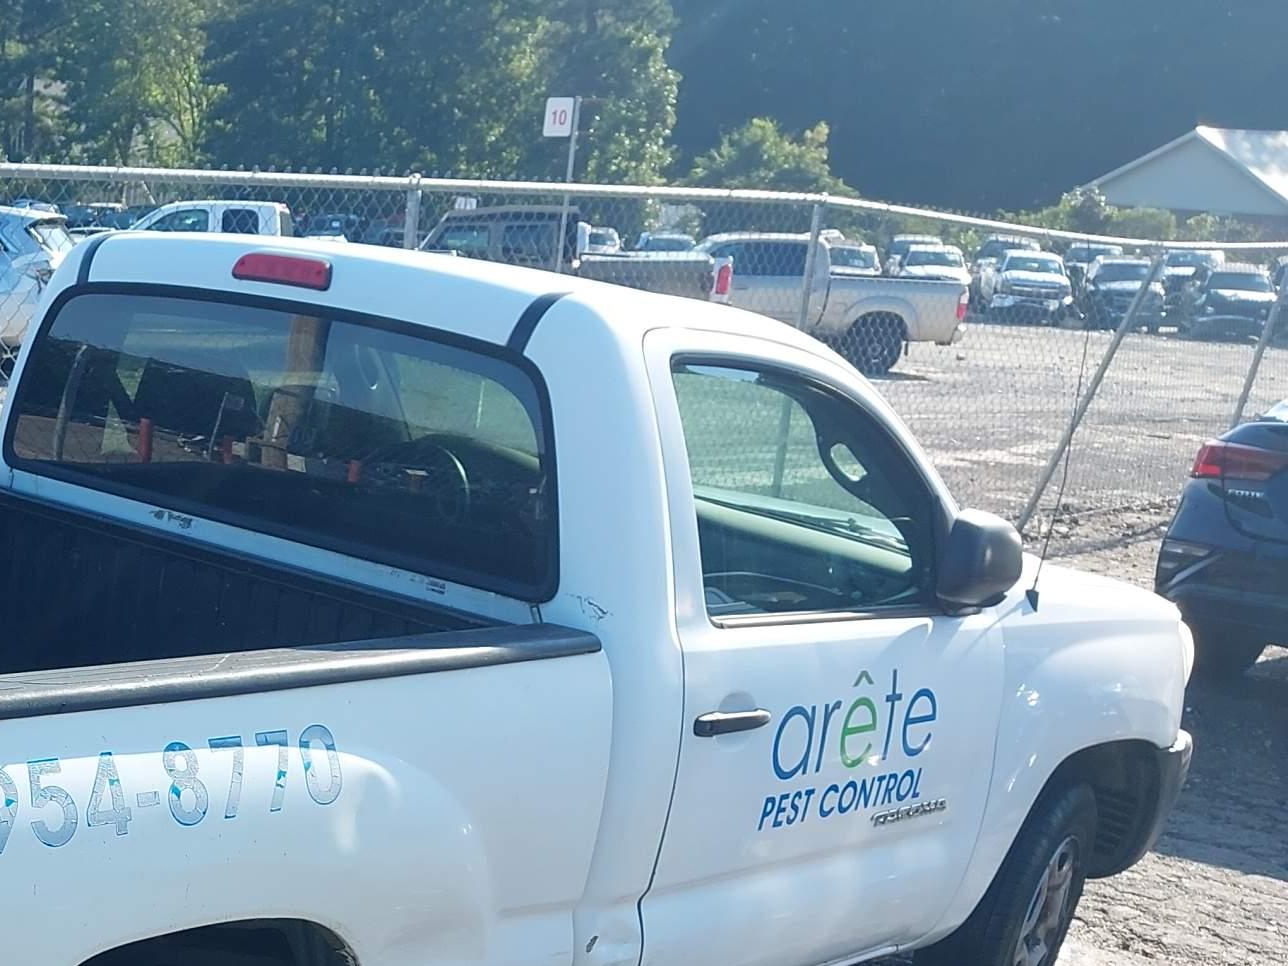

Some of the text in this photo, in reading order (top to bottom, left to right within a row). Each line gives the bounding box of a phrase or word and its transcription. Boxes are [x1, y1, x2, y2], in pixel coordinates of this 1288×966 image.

[551, 109, 568, 126] 10
[757, 767, 923, 832] PEST CONTROL
